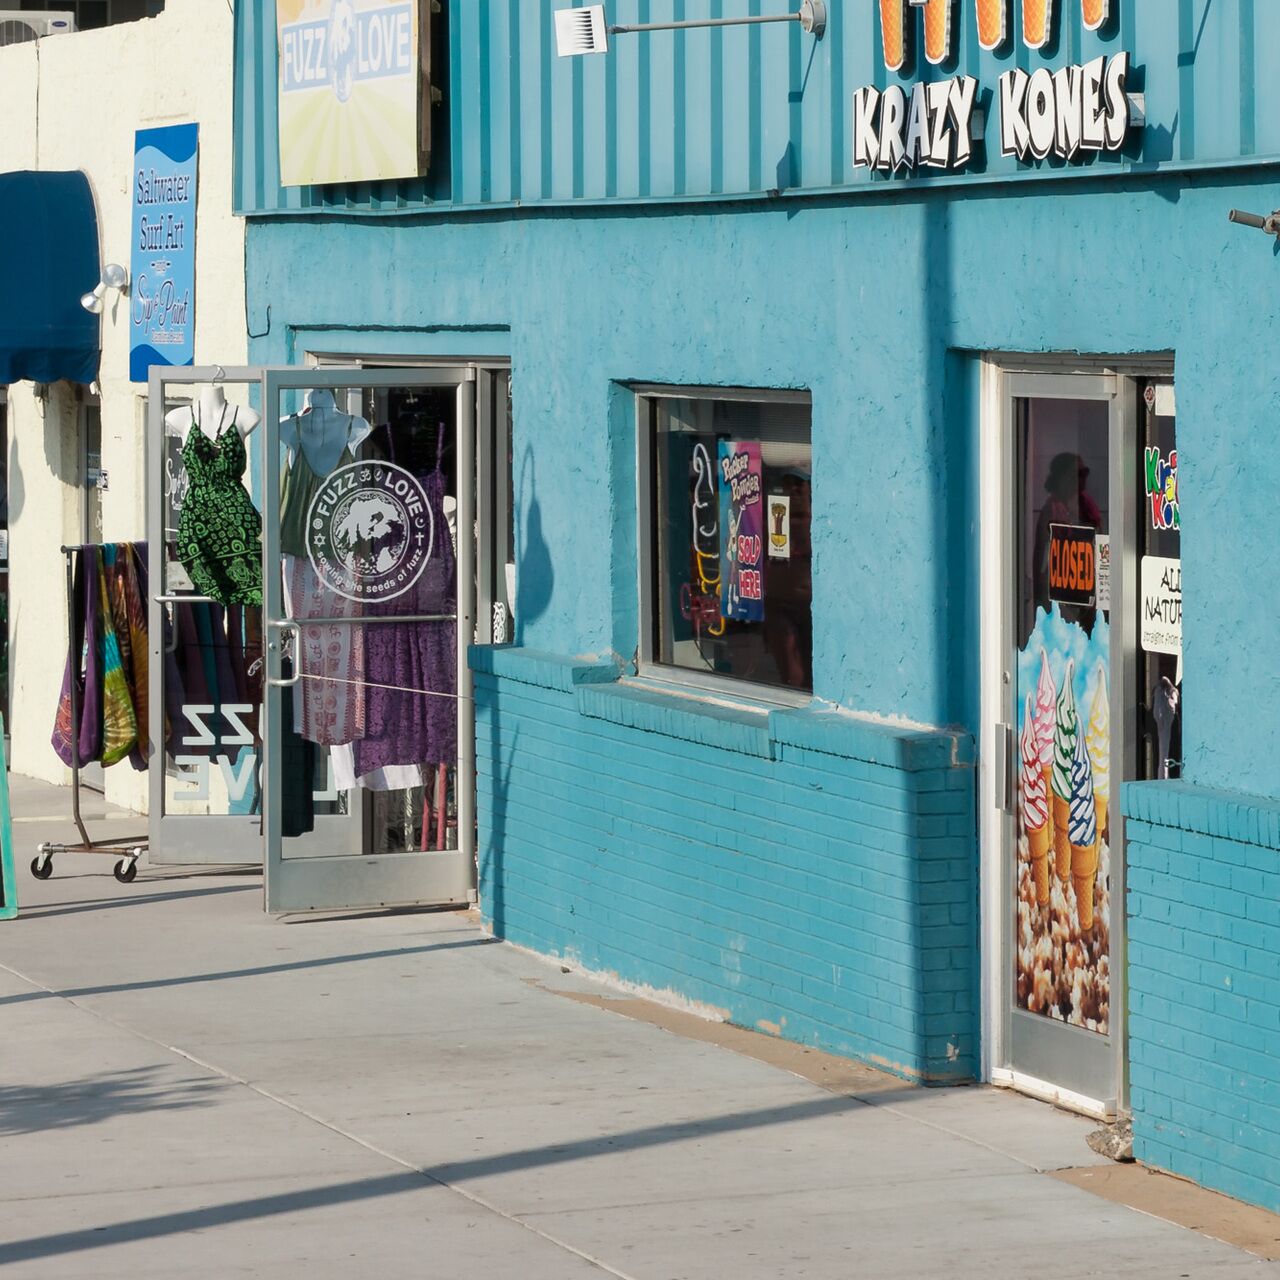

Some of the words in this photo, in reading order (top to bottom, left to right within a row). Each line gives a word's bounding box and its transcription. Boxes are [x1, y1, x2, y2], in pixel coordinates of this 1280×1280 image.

[283, 27, 327, 84] FUZZ
[358, 11, 410, 73] LOVE
[853, 75, 979, 172] KRAZY
[999, 51, 1130, 160] KONES
[137, 170, 190, 205] Saltwater
[140, 215, 164, 250] Surf
[165, 214, 185, 250] Art
[133, 275, 154, 334] Sip
[158, 280, 188, 326] Paint
[317, 472, 358, 517] FUZZ
[384, 472, 424, 517] LOVE
[317, 551, 344, 586] sowing
[366, 579, 396, 593] seeds
[397, 568, 409, 581] of
[407, 548, 424, 571] fuzz
[738, 535, 761, 566] SOLD
[1050, 538, 1095, 591] CLOSED
[738, 569, 761, 599] HERE
